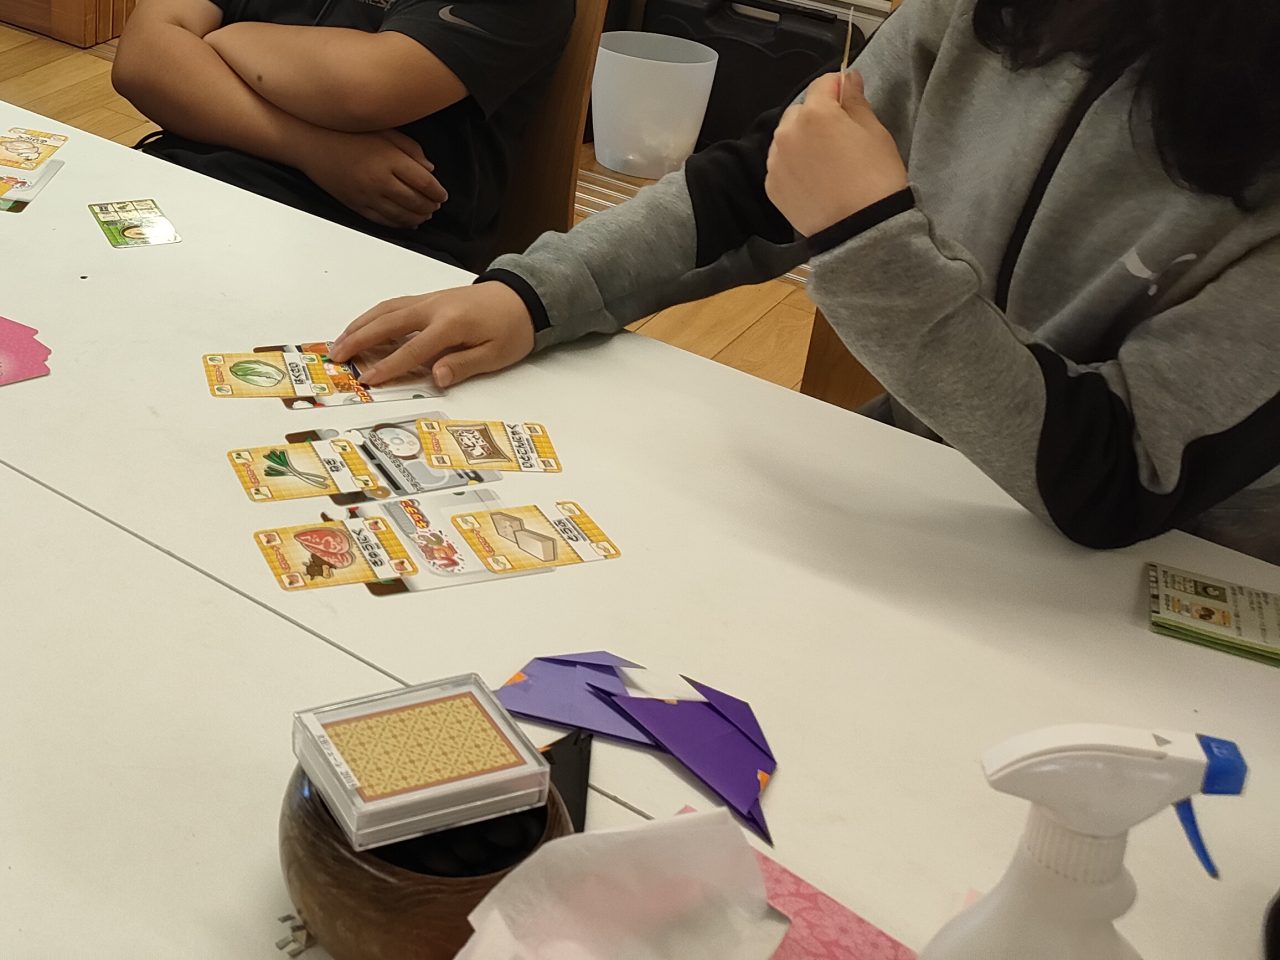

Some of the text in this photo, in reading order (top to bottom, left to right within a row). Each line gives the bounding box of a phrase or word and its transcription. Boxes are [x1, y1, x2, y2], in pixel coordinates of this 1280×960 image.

[288, 361, 303, 385] はくさい
[348, 373, 374, 405] カウンター
[506, 423, 534, 470] いとこんにゃく
[351, 527, 384, 568] ぎゅうにく
